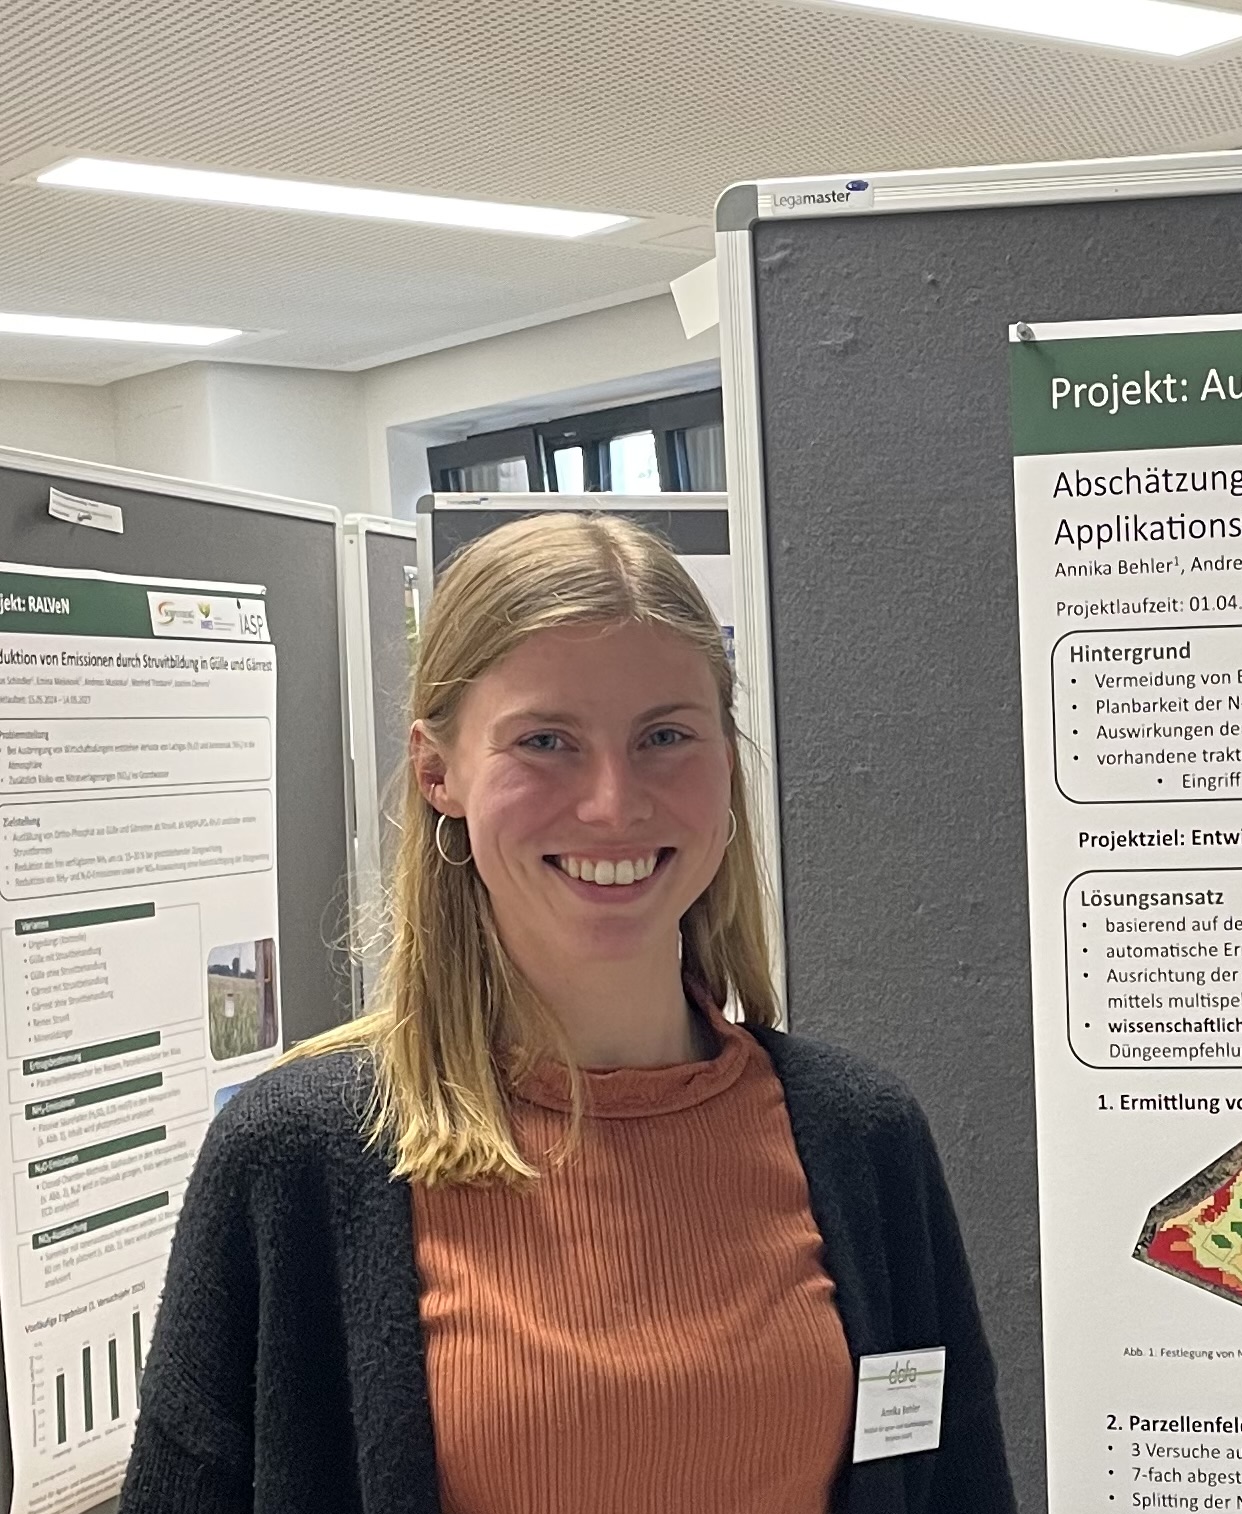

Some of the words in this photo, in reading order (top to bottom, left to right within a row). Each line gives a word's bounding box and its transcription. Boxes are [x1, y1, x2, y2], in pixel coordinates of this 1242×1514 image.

[773, 191, 851, 210] Legamaster
[1051, 370, 1188, 415] Projekt:
[28, 596, 70, 615] RALVeN
[1056, 596, 1184, 620] Projektlaufzeit:
[40, 655, 58, 666] von
[61, 652, 113, 667] Emissionen
[1070, 640, 1191, 666] Hintergrund
[1094, 670, 1197, 690] Vermeidung
[1200, 672, 1232, 686] von
[1096, 696, 1190, 715] Planbarkeit
[1194, 695, 1223, 712] der
[1078, 828, 1185, 852] Projektziel:
[1080, 889, 1225, 911] Lösungsansatz
[1105, 916, 1186, 933] basierend
[1191, 915, 1219, 932] auf
[1107, 993, 1164, 1009] mittels
[1097, 1094, 1114, 1111] 1.
[1120, 1093, 1221, 1115] Ermittlung
[1106, 1414, 1123, 1431] 2.
[1131, 1466, 1182, 1483] 7-fach
